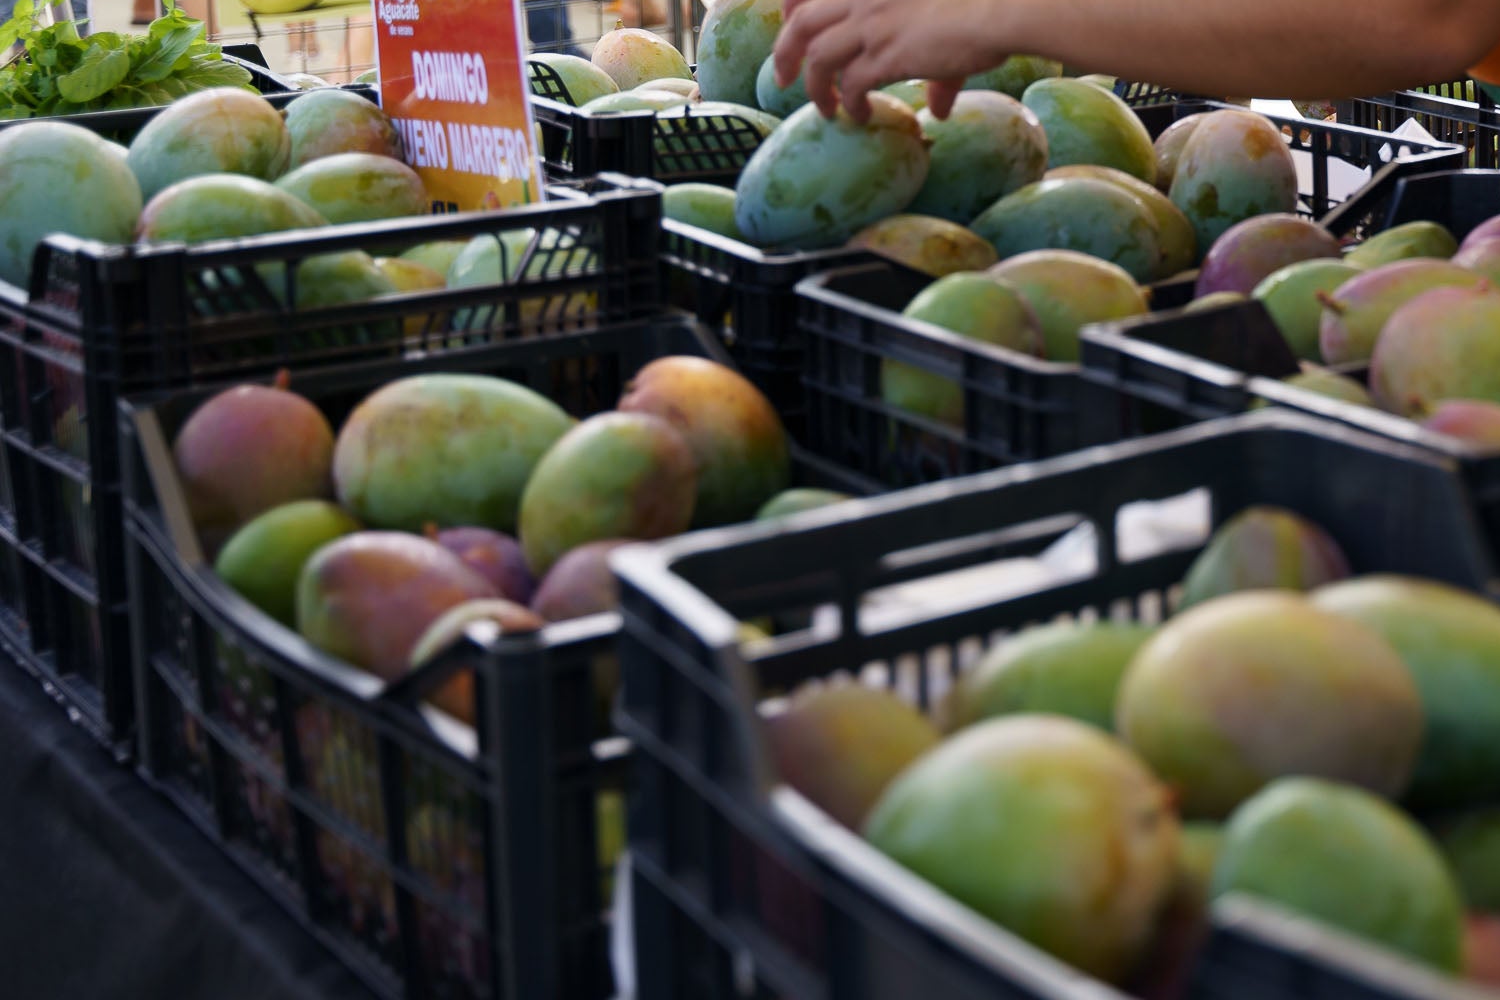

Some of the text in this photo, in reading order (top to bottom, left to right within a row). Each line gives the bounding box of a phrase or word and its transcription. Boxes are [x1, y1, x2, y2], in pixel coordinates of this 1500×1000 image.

[379, 0, 420, 24] Aguacate
[412, 50, 489, 104] DOMINGO
[447, 122, 530, 182] MARRERO
